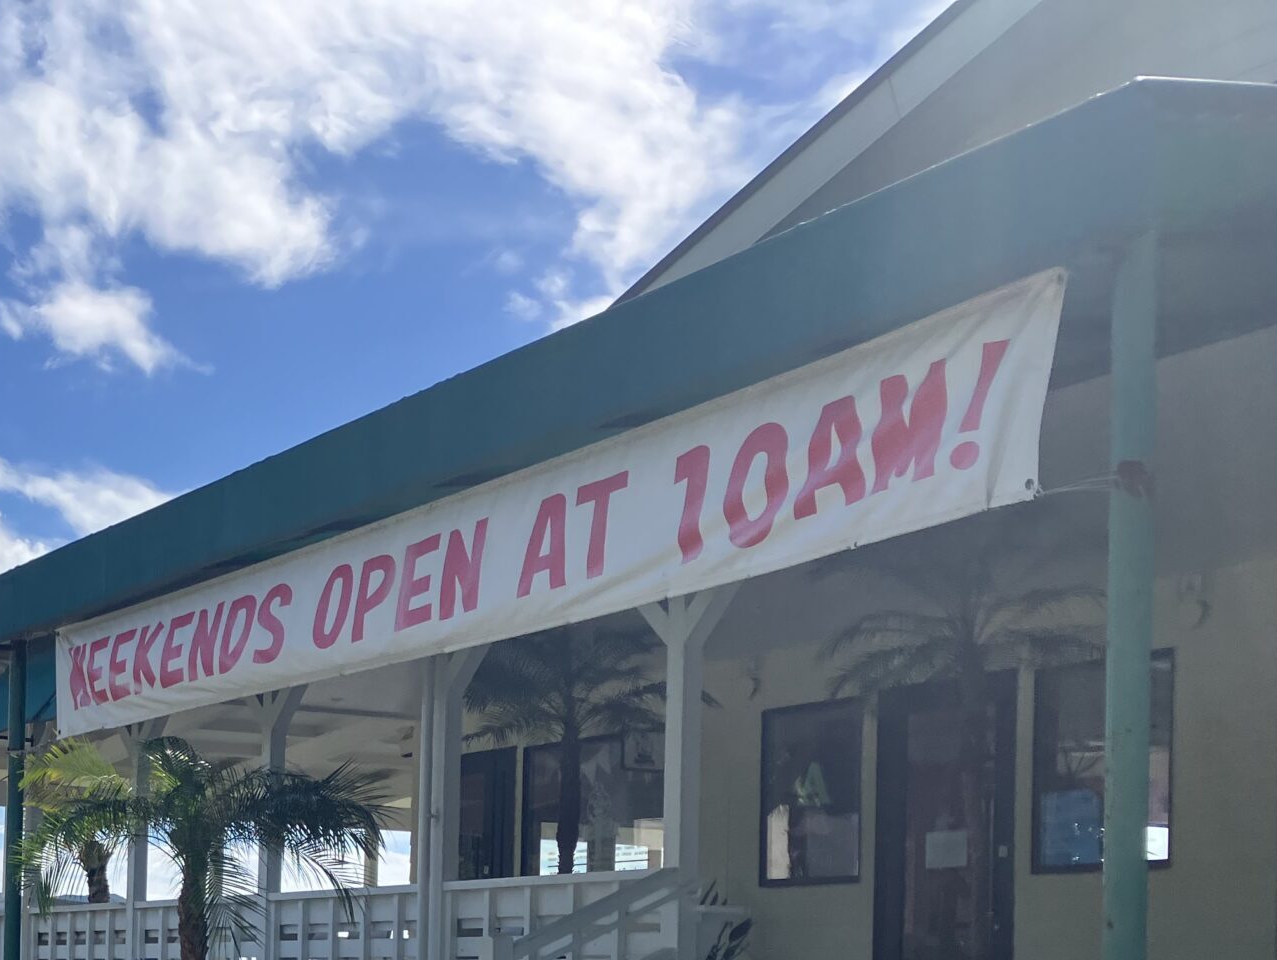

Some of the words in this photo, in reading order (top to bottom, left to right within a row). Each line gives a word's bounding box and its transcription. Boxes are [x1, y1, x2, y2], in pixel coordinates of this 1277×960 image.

[312, 517, 489, 649] OPEN
[517, 470, 629, 599] AT
[674, 338, 1011, 564] 10AM!
